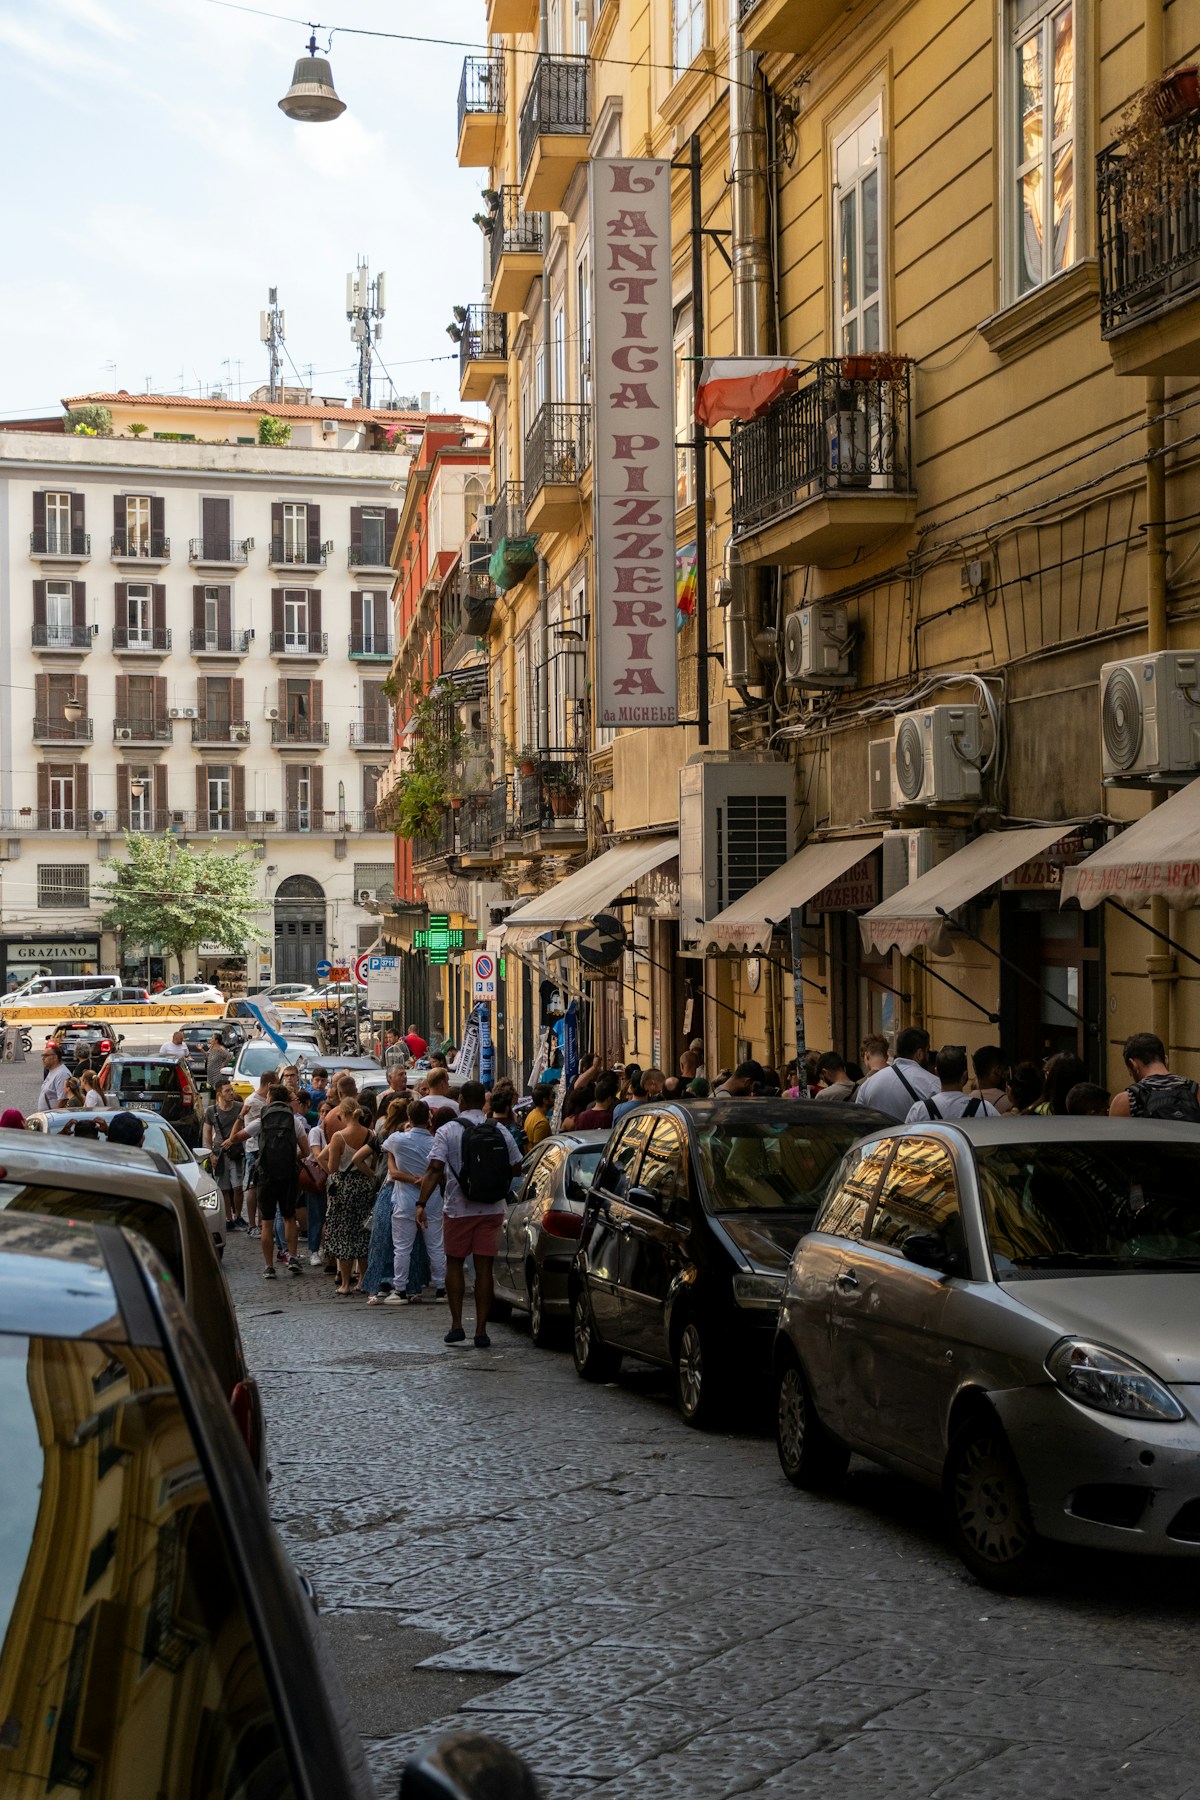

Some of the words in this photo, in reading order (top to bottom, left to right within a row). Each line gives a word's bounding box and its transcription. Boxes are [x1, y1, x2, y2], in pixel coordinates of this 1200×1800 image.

[611, 433, 667, 696] PIZZERIA
[603, 709, 616, 721] da
[618, 706, 675, 721] MICHELE
[1076, 870, 1096, 892] DA
[1100, 865, 1162, 891] MICHELE
[1166, 862, 1200, 888] 1870
[869, 920, 930, 941] PIZZERIA
[18, 947, 87, 958] GRAZIANO
